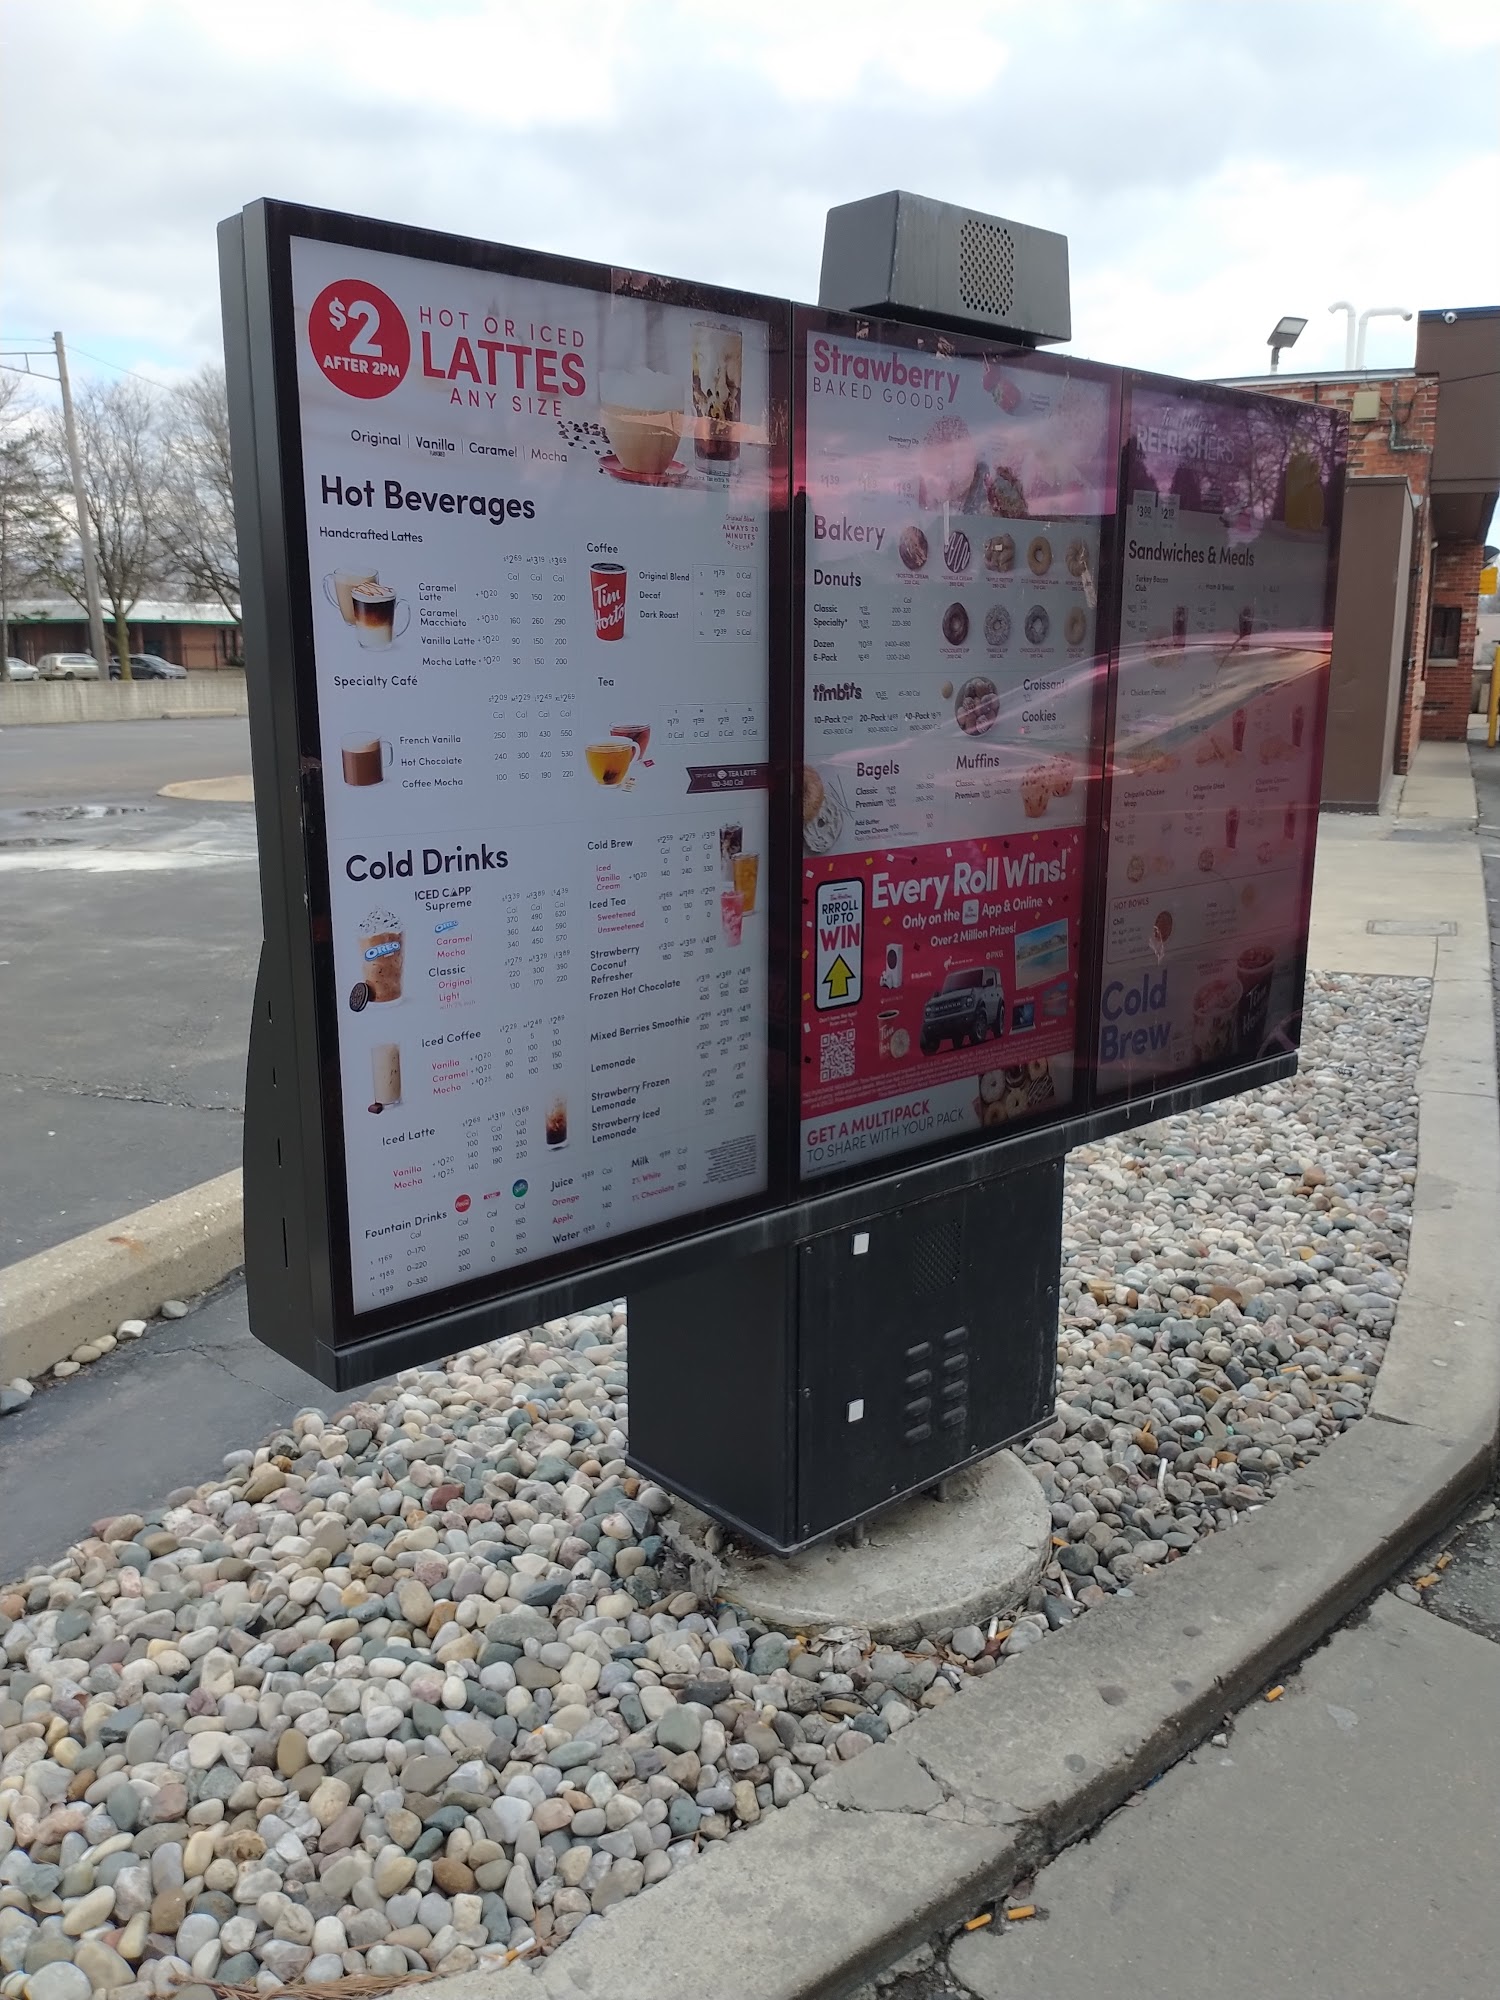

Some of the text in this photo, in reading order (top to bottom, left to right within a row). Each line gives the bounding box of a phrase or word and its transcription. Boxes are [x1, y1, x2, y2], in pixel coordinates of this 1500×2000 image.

[329, 297, 383, 357] $2
[419, 305, 584, 348] HOT OR ICED
[323, 355, 400, 378] AFTER 2PM
[421, 331, 587, 397] LATTES
[814, 339, 960, 403] Strawberry
[813, 377, 944, 411] BAKED GOODS
[450, 388, 562, 417] ANY SIZE
[351, 429, 568, 462] Original Vanilla Caramel Mocha
[321, 474, 535, 525] Hot Beverages
[319, 527, 423, 543] Handcrafted Lattes
[814, 514, 886, 550] Bakery
[587, 543, 619, 553] Coffee
[1129, 540, 1254, 566] Sandwiches & Meals
[639, 572, 689, 581] Original Blend
[814, 569, 862, 587] Donuts
[1136, 575, 1152, 583] Turkey
[419, 583, 456, 592] Caramel
[419, 593, 441, 601] Latte
[594, 583, 620, 608] Tim
[639, 591, 661, 599] Decaf
[420, 609, 458, 617] Caramel
[640, 611, 679, 619] Dark Roast
[814, 604, 838, 614] Classic
[421, 618, 466, 627] Macchiato
[421, 636, 475, 645] Vanilla Latte
[814, 640, 835, 648] Dozen
[422, 658, 476, 666] Mocha Latte
[814, 652, 838, 662] 6-Pack
[334, 675, 418, 689] Specialty Café
[598, 677, 614, 686] Tea
[813, 682, 863, 702] timbits
[814, 712, 886, 724] 10-Pack 20-Pack
[1022, 710, 1057, 722] Cookies
[400, 736, 429, 744] French
[432, 735, 461, 744] Vanilla
[401, 757, 462, 766] Hot Chocolate
[956, 754, 1000, 770] Muffins
[857, 760, 900, 780] Bagels
[402, 779, 463, 788] Coffee Mocha
[856, 787, 878, 795] Classic
[856, 800, 883, 809] Premium
[588, 840, 633, 850] Cold Brew
[346, 844, 509, 881] Cold Drinks
[596, 864, 611, 872] Iced
[596, 874, 620, 882] Vanilla
[872, 872, 950, 910] Every
[953, 857, 998, 896] Roll
[597, 883, 620, 891] Cream
[415, 889, 439, 900] ICED
[425, 899, 472, 912] Supreme
[589, 898, 626, 909] Iced Tea
[822, 900, 859, 915] RRROLL
[598, 910, 636, 921] Sweetened
[826, 913, 854, 925] UP TO
[902, 897, 1043, 930] Only on the App & Online
[598, 921, 644, 933] Unsweetened
[436, 935, 473, 946] Caramel
[820, 923, 860, 951] WIN
[931, 924, 1016, 947] Over 2 Million Prizes!
[365, 941, 400, 961] OREO
[437, 949, 465, 958] Mocha
[590, 946, 640, 960] Strawberry
[429, 965, 466, 977] Classic
[591, 959, 627, 972] Coconut
[438, 978, 473, 989] Original
[591, 971, 633, 984] Refresher
[439, 992, 460, 1002] Light
[589, 980, 680, 1001] Frozen Hot Chocolate
[1102, 968, 1168, 1021] Cold
[590, 1016, 690, 1042] Mixed Berries Smoothie
[421, 1030, 481, 1047] Iced Coffee
[1101, 1022, 1171, 1064] Brew
[432, 1059, 460, 1070] Vanilla
[591, 1056, 636, 1073] Lemonade
[433, 1070, 468, 1083] Caramel
[433, 1084, 461, 1095] Mocha
[591, 1077, 670, 1101] Strawberry Frozen
[592, 1097, 636, 1113] Lemonade
[592, 1108, 660, 1132] Strawberry Iced
[808, 1100, 931, 1146] GET A MULTIPACK
[382, 1127, 436, 1146] Iced Latte
[592, 1127, 637, 1144] Lemonade
[807, 1107, 964, 1162] TO SHARE WITH YOUR PACK
[631, 1156, 649, 1167] Milk
[393, 1166, 422, 1178] Vanilla
[642, 1171, 661, 1182] White
[394, 1178, 423, 1190] Mocha
[550, 1177, 574, 1191] Juice
[641, 1184, 674, 1199] Chocolate
[552, 1194, 580, 1207] Orange
[365, 1211, 447, 1239] Fountain Drinks
[552, 1214, 574, 1225] Apple
[552, 1230, 580, 1244] Water
